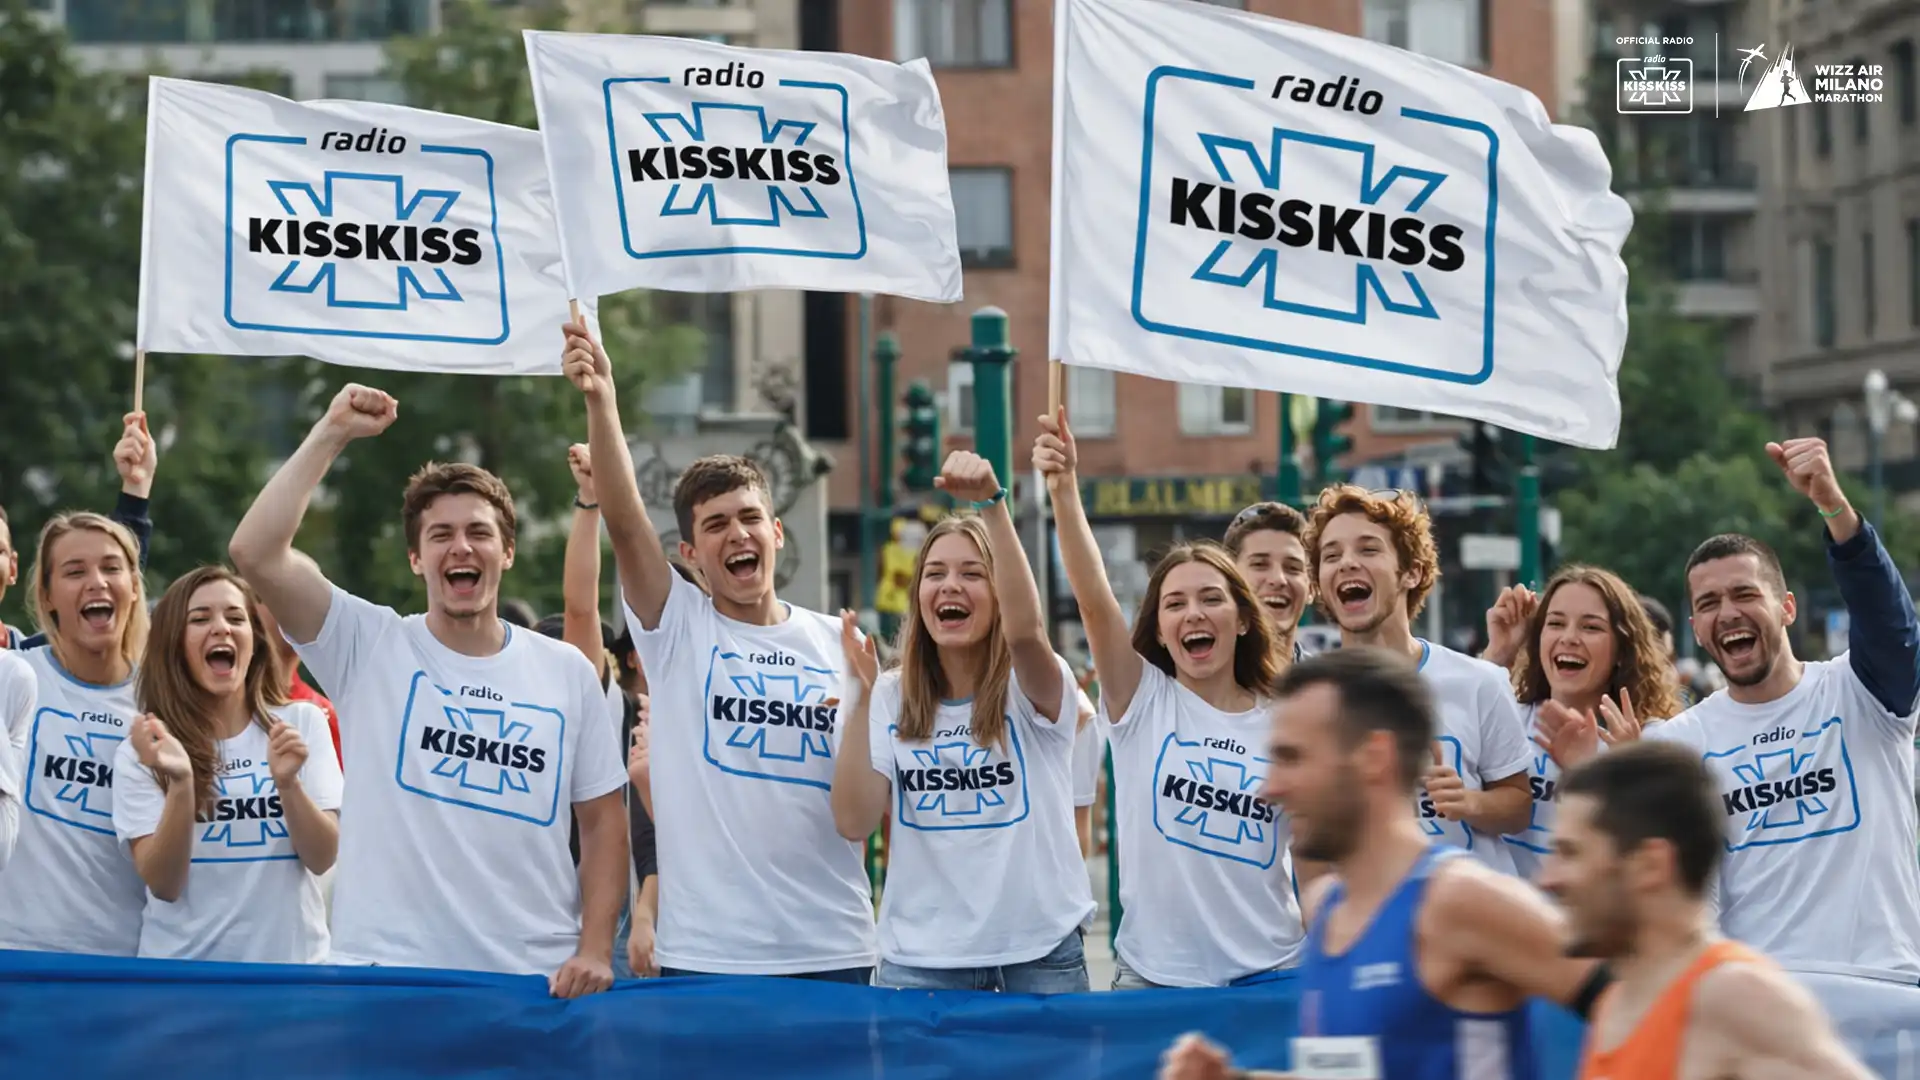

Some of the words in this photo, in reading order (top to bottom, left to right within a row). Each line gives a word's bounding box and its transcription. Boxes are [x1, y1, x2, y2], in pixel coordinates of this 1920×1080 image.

[683, 61, 765, 90] radio
[1271, 75, 1384, 116] radio
[320, 127, 407, 154] radio
[628, 146, 841, 185] KISSKISS
[1169, 176, 1466, 273] KISSKISS
[248, 217, 482, 266] KISSKISS
[460, 685, 503, 702] radio
[81, 711, 124, 727] radio
[420, 726, 546, 773] KISKISS
[1203, 737, 1246, 755] radio
[1752, 726, 1796, 746] radio
[899, 761, 1015, 792] KISSKISS
